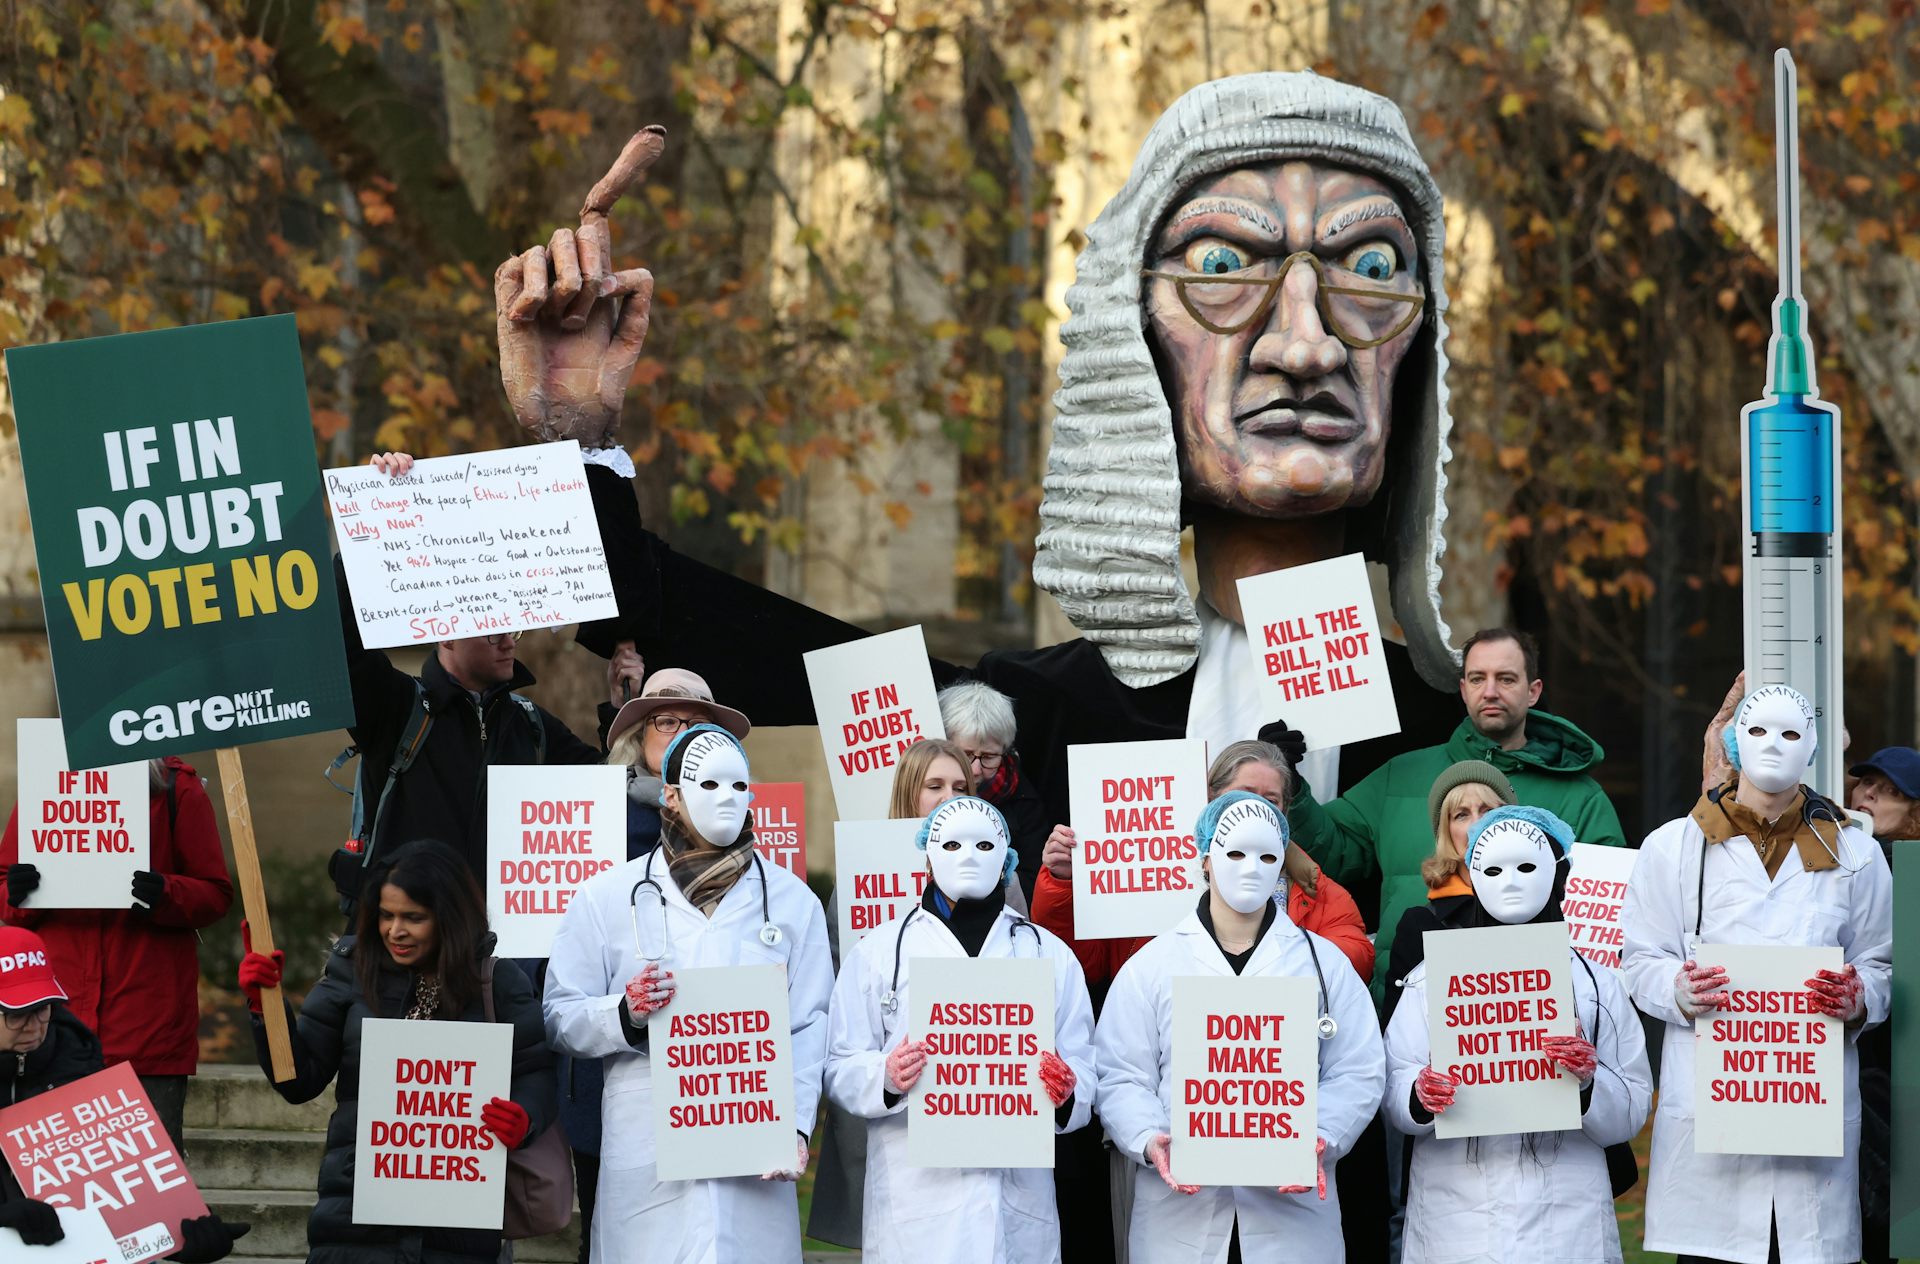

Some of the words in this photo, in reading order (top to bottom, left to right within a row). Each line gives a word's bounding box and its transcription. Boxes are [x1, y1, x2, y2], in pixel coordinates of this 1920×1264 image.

[1813, 425, 1819, 436] 1
[103, 426, 160, 492] IF
[172, 415, 242, 483] IN
[328, 474, 384, 498] Physician
[389, 474, 424, 487] assisted
[336, 501, 361, 514] Will
[371, 497, 410, 513] Change
[413, 492, 433, 506] the
[438, 496, 457, 511] face
[460, 494, 472, 509] of
[517, 481, 541, 502] Life
[552, 479, 585, 493] death
[1813, 495, 1821, 506] 2
[76, 481, 284, 568] DOUBT
[343, 521, 380, 539] Why
[387, 514, 424, 530] Now?
[383, 540, 411, 552] NHS
[383, 560, 402, 572] Yet
[434, 555, 467, 568] Hospice
[507, 549, 529, 560] Good
[1814, 564, 1822, 575] 3
[391, 578, 443, 592] Canadian
[452, 574, 480, 585] Dutch
[510, 570, 521, 578] in
[61, 562, 222, 641] VOTE
[230, 549, 319, 618] NO
[1263, 617, 1313, 647] KILL
[1315, 605, 1361, 635] THE
[1814, 635, 1823, 645] 4
[1264, 646, 1321, 676] BILL,
[1324, 632, 1369, 663] NOT
[1278, 672, 1324, 701] THE
[1327, 665, 1369, 692] ILL.
[234, 688, 274, 711] NOT
[851, 690, 870, 716] IF
[875, 683, 899, 710] IN
[1815, 707, 1823, 718] 5
[109, 695, 236, 746] care
[236, 700, 311, 728] KILLING
[843, 708, 920, 747] DOUBT,
[838, 743, 895, 777] VOTE
[59, 771, 79, 794] IF
[85, 771, 107, 794] IN
[1102, 776, 1174, 803] DON'T
[43, 800, 124, 828] DOUBT,
[521, 801, 594, 825] DON'T
[1105, 806, 1174, 833] MAKE
[32, 830, 89, 853] VOTE
[97, 829, 135, 853] NO.
[522, 830, 592, 854] MAKE
[1085, 835, 1197, 864] DOCTORS
[1472, 821, 1548, 872] EUTHANISER
[854, 873, 906, 899] KILL
[911, 872, 932, 896] T
[1090, 866, 1194, 894] KILLERS.
[505, 890, 576, 914] KILLE
[1588, 925, 1624, 946] THE
[0, 950, 46, 973] DPAC
[1448, 969, 1551, 998] ASSISTED
[669, 1010, 770, 1038] ASSISTED
[929, 1003, 1034, 1026] ASSISTED
[1445, 1000, 1532, 1027] SUICIDE
[1537, 998, 1558, 1021] IS
[1207, 1014, 1284, 1041] DON'T
[1712, 1020, 1800, 1044] SUICIDE
[1806, 1022, 1827, 1044] IS
[667, 1041, 751, 1068] SUICIDE
[756, 1039, 776, 1062] IS
[925, 1033, 1012, 1056] SUICIDE
[1018, 1033, 1038, 1056] IS
[1458, 1031, 1501, 1056] NOT
[396, 1058, 477, 1086] DON'T
[1208, 1047, 1282, 1073] MAKE
[1448, 1058, 1562, 1086] SOLUTION.
[1723, 1050, 1768, 1073] NOT
[1773, 1051, 1816, 1074] THE
[679, 1073, 722, 1097] NOT
[726, 1070, 768, 1094] THE
[936, 1063, 980, 1086] NOT
[985, 1063, 1027, 1086] THE
[396, 1090, 472, 1118] MAKE
[924, 1093, 1038, 1116] SOLUTION.
[1185, 1079, 1305, 1106] DOCTORS
[1711, 1079, 1827, 1105] SOLUTION.
[6, 1112, 70, 1149] THE
[72, 1088, 141, 1126] BILL
[669, 1099, 780, 1128] SOLUTION.
[1189, 1112, 1299, 1139] KILLERS.
[18, 1107, 149, 1167] SAFEGUARDS
[370, 1121, 494, 1150] DOCTORS
[32, 1120, 158, 1196] ARENT
[374, 1153, 486, 1182] KILLERS.
